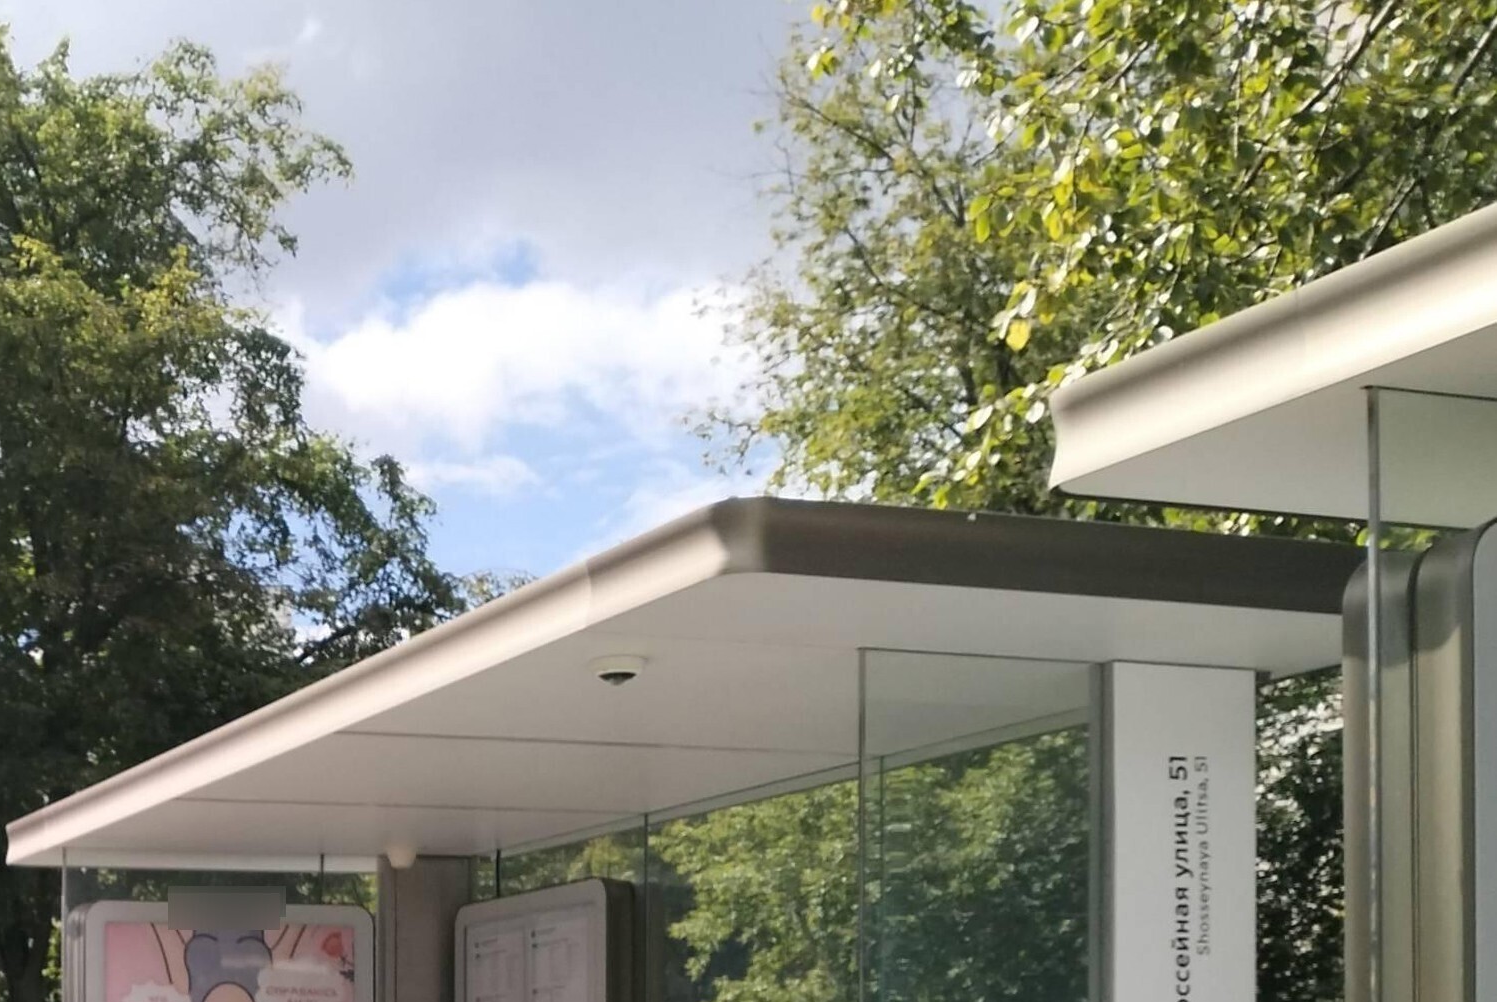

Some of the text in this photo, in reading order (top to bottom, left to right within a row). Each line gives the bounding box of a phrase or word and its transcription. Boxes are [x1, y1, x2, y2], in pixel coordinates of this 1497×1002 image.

[1168, 756, 1188, 780] 51
[1174, 790, 1194, 878] улица,
[1193, 755, 1212, 956] Shosseynaya Ulitsa, 51
